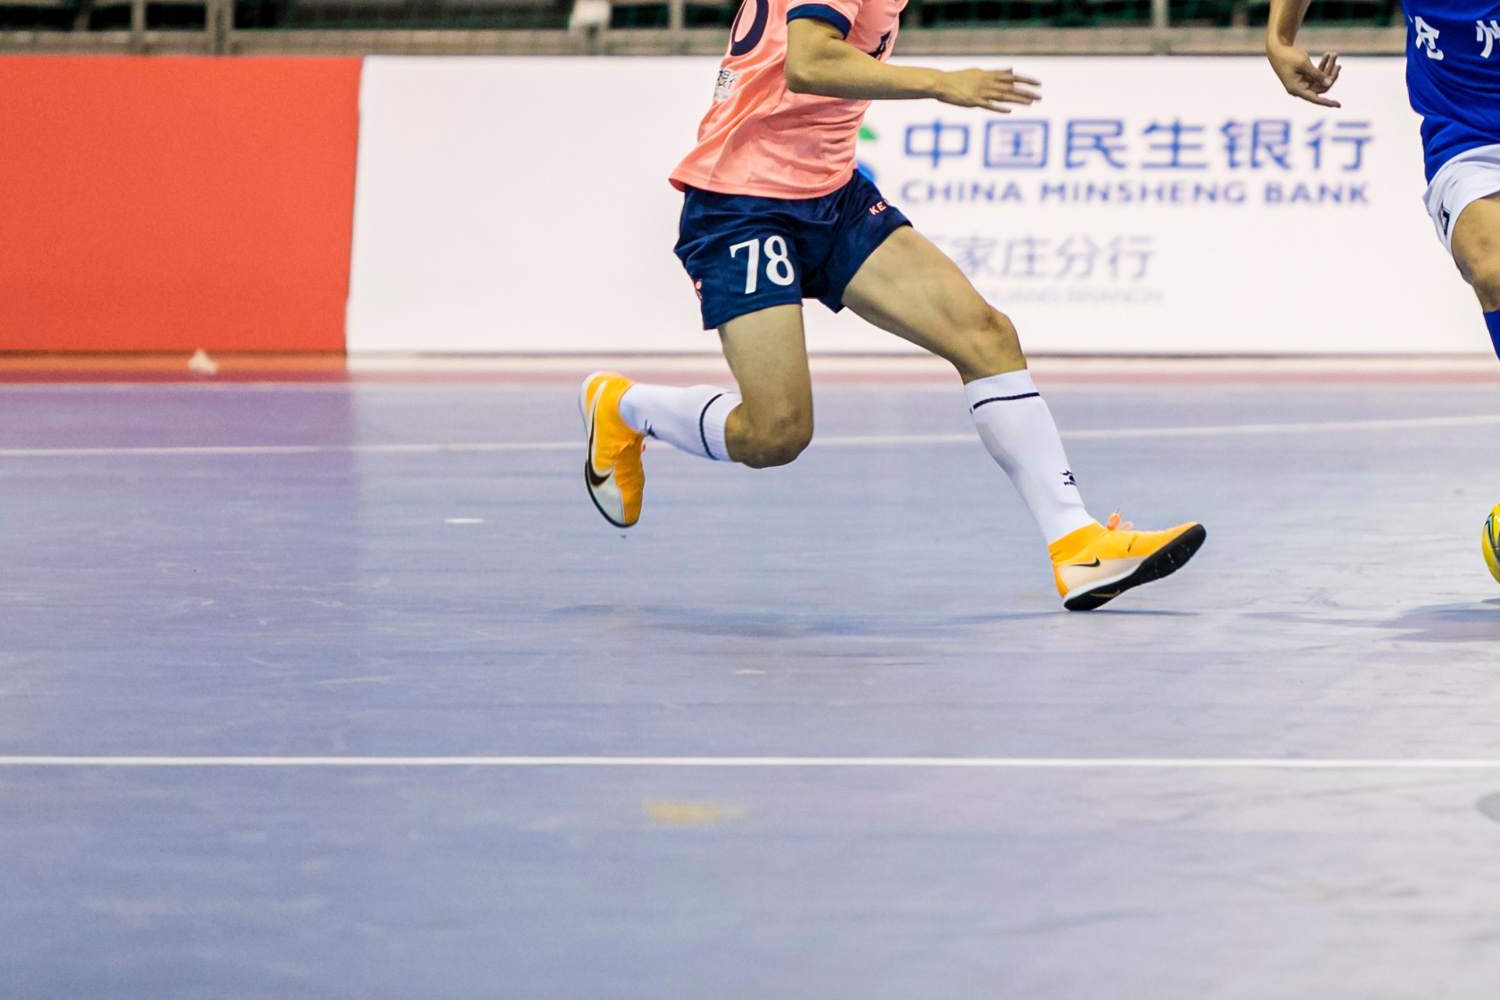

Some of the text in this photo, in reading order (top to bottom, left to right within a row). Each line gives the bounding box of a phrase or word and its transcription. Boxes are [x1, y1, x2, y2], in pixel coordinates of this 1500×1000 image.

[903, 118, 1374, 171] 中国民生银行
[901, 181, 1369, 204] CHINA MINSHENG BANK
[729, 234, 795, 295] 78
[927, 233, 1156, 280] 家庄分行
